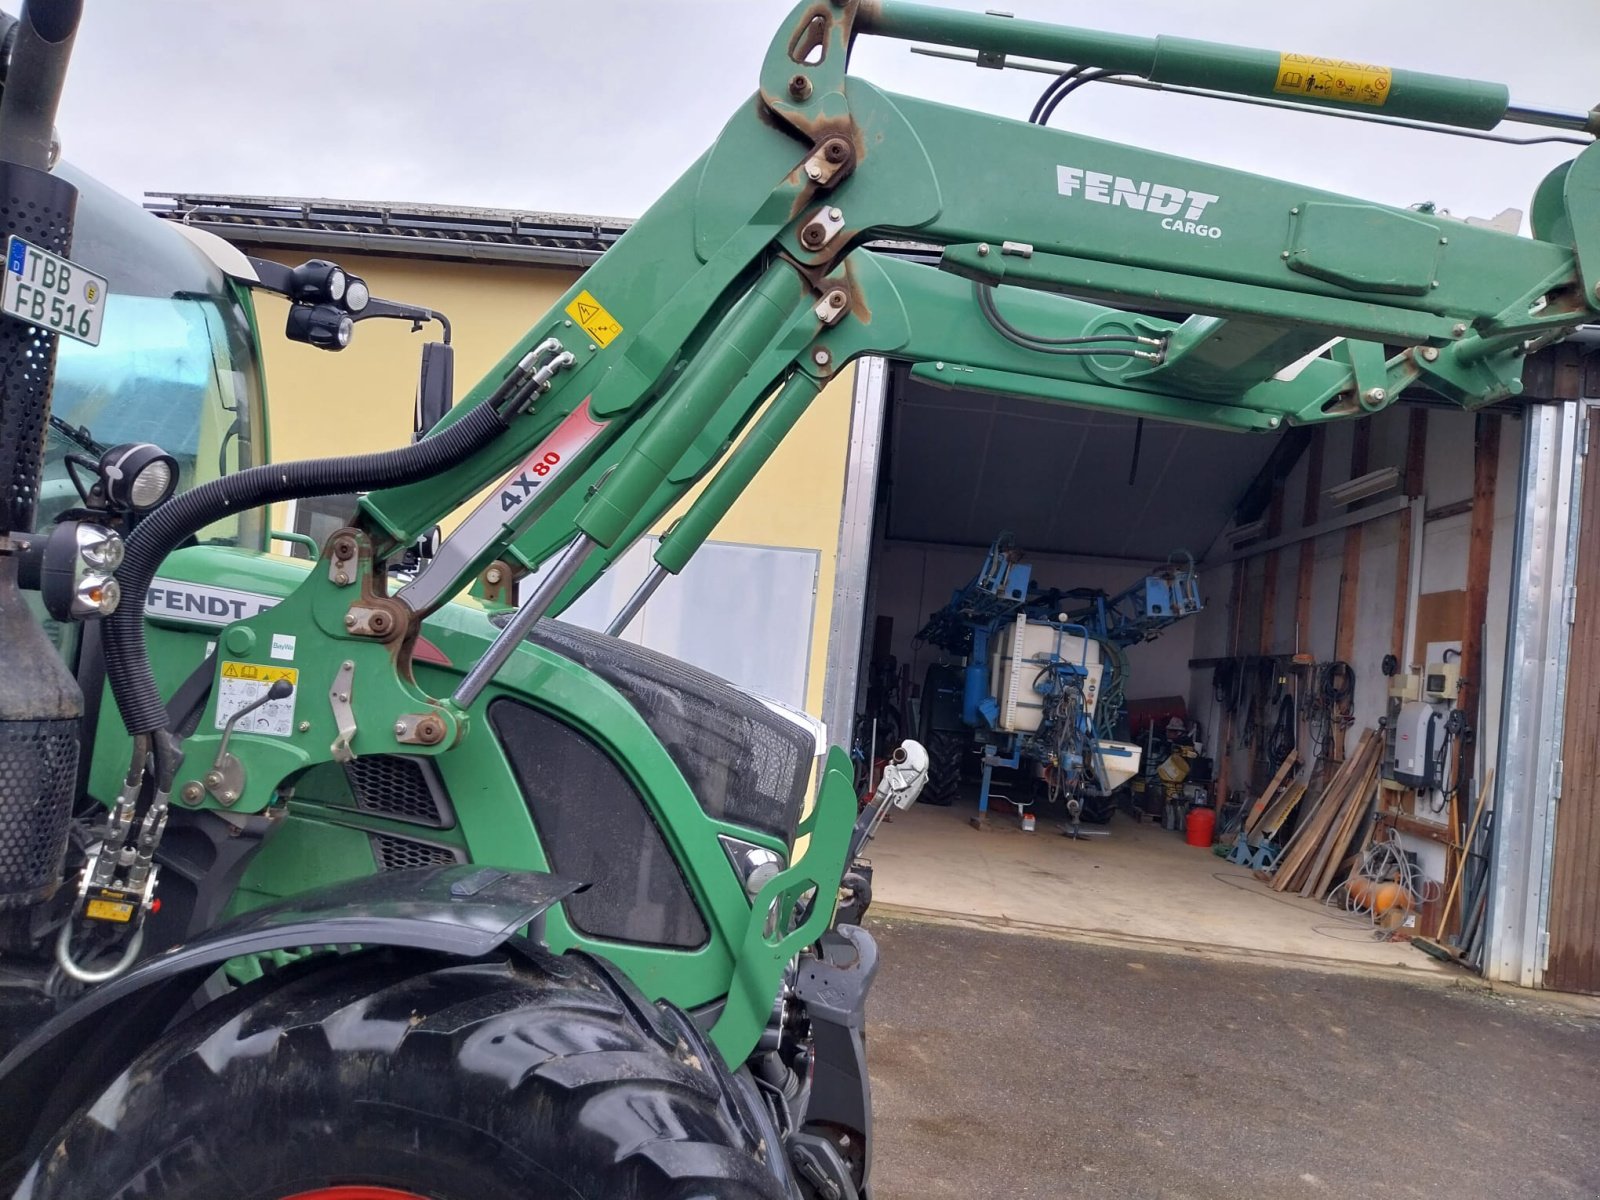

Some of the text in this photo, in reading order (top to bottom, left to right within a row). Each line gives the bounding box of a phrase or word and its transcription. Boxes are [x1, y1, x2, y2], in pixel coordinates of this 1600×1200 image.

[1056, 164, 1220, 221] FENDT
[1161, 217, 1222, 239] CARGO
[13, 260, 21, 271] D
[29, 249, 72, 295] TBB
[14, 282, 91, 338] FB 516
[147, 587, 247, 619] FENDT
